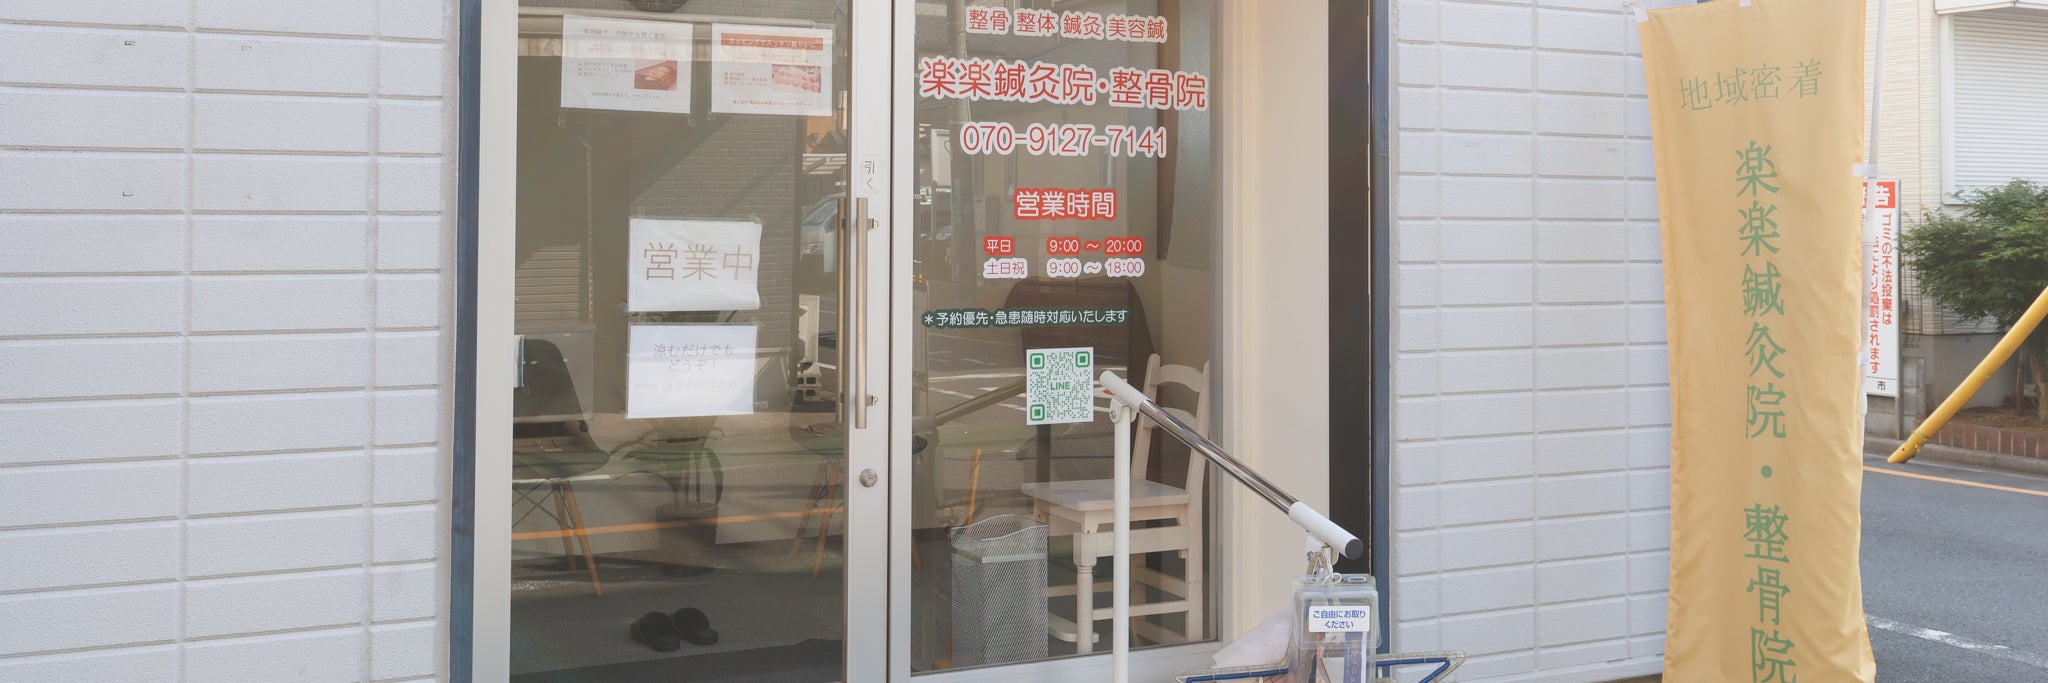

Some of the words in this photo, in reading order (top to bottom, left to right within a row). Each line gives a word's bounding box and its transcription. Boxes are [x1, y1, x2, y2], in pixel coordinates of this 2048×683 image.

[969, 9, 1008, 31] 整骨
[1017, 11, 1055, 33] 整体
[1064, 14, 1101, 36] 鍼灸
[1109, 17, 1165, 39] 美容鍼
[922, 58, 1206, 108] 楽楽鍼灸院・整骨院
[1678, 58, 1823, 111] 地域密着
[963, 125, 1166, 154] 070-9127-7141
[864, 160, 875, 190] 引く
[1016, 191, 1115, 218] 営業時間
[986, 239, 1011, 253] 平日
[1050, 239, 1079, 253] 9:00
[1106, 239, 1142, 253] 20:00
[643, 242, 753, 281] 営業中
[986, 261, 1025, 275] 土日祝
[1050, 261, 1079, 275] 9:00
[1107, 261, 1142, 275] 18:00
[1882, 213, 1892, 325] ゴミの不法投棄は
[653, 343, 734, 358] 涼むだけでも
[1050, 382, 1070, 390] LINE
[1734, 139, 1797, 683] 楽楽鍼灸院・整骨院
[1313, 610, 1366, 619] ご自由にお取り
[1325, 620, 1354, 629] ください
